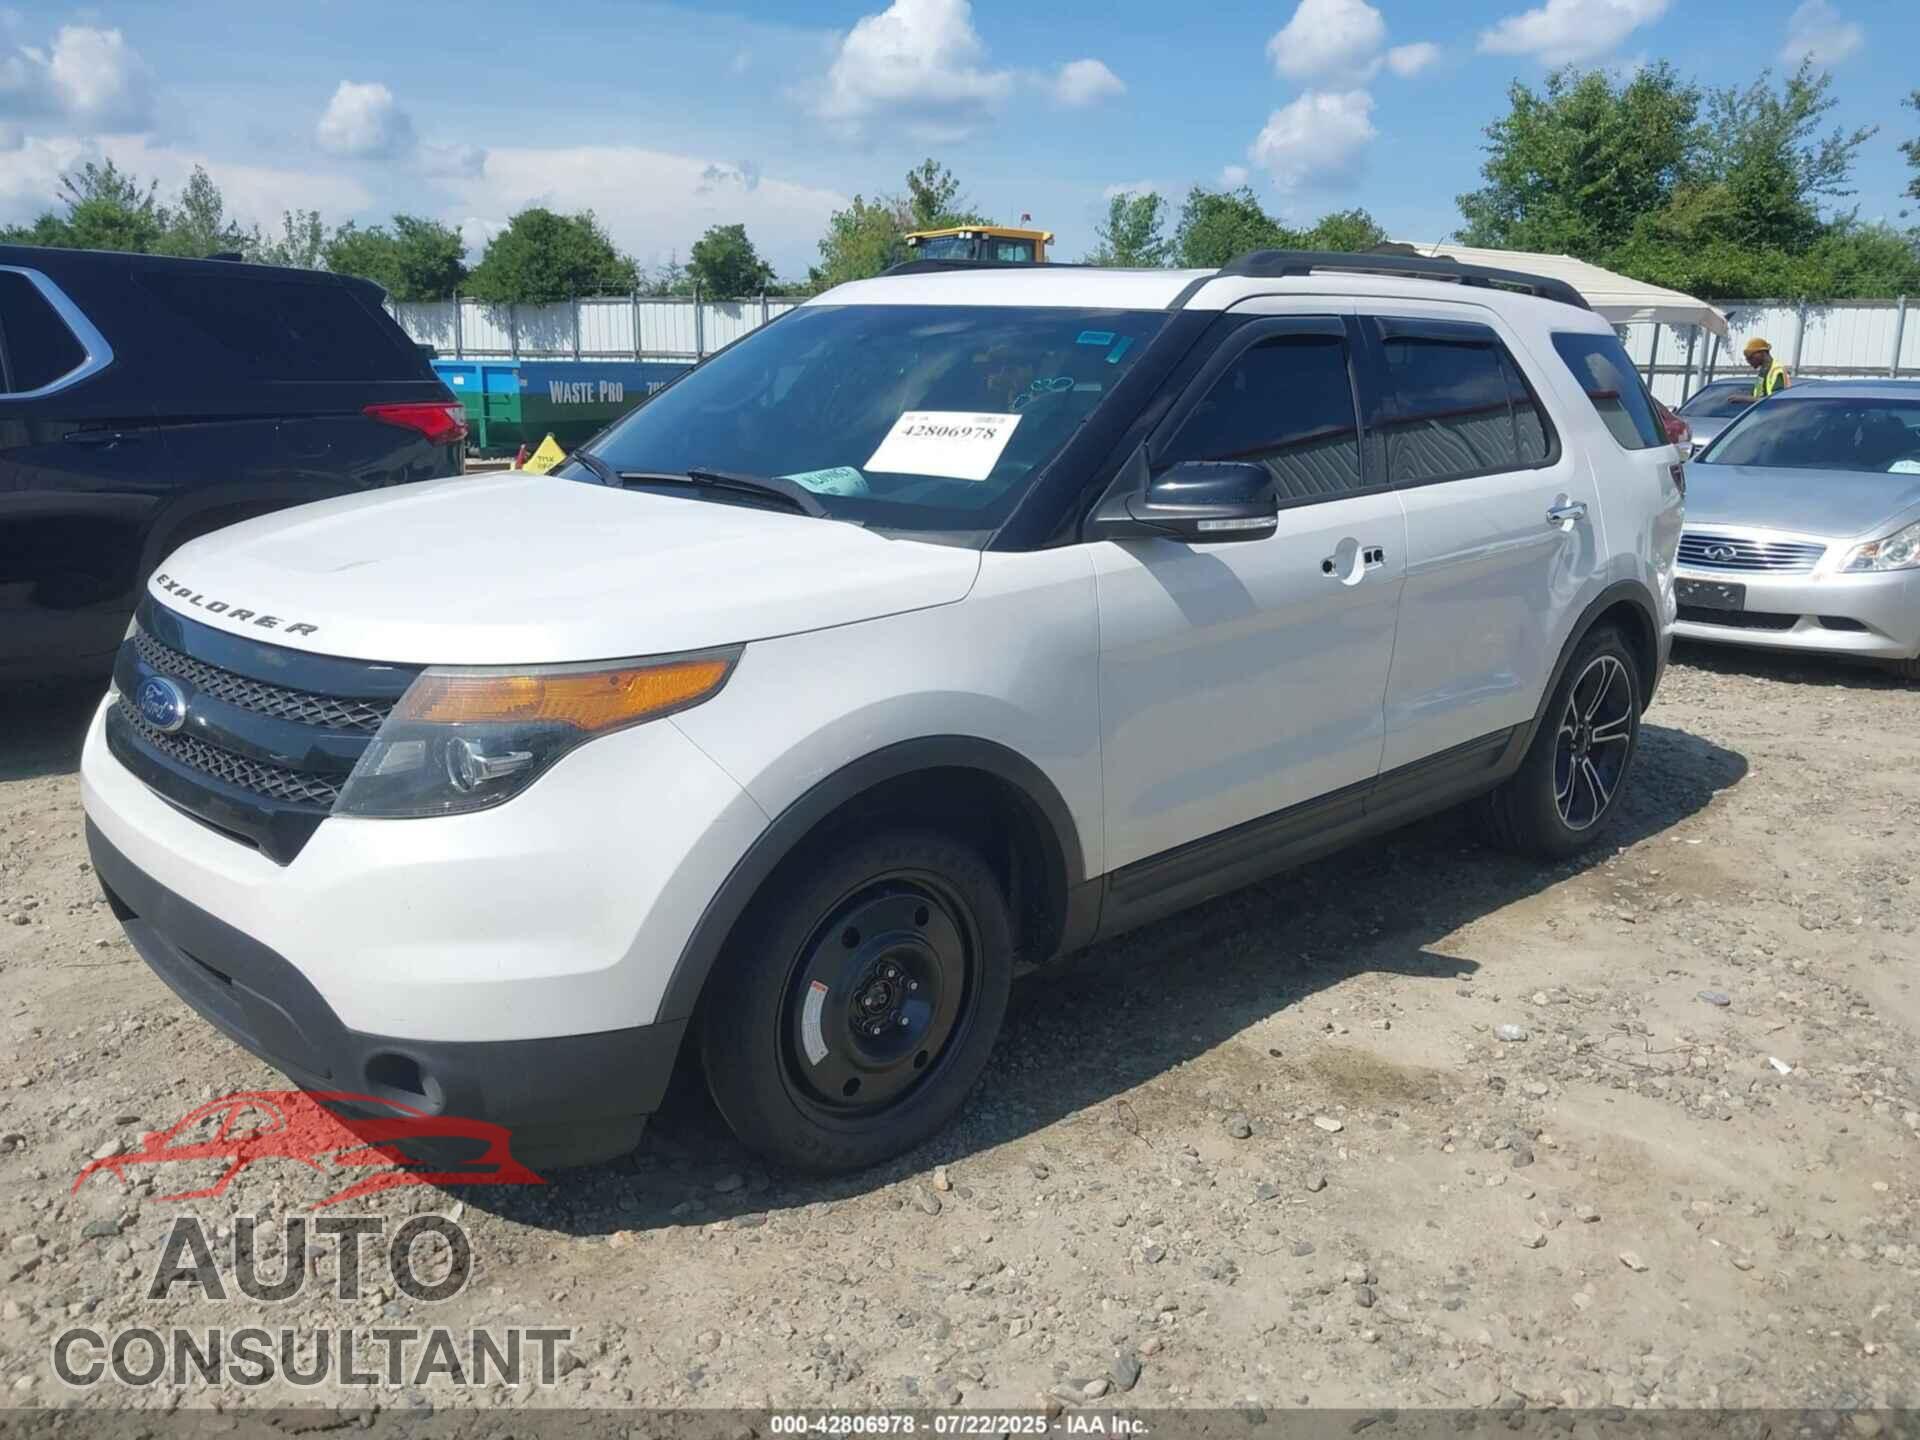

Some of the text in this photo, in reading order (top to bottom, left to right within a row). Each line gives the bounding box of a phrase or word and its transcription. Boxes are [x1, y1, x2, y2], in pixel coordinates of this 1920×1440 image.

[901, 424, 998, 440] 42806978
[156, 573, 319, 637] EXPLORER
[143, 683, 170, 720] Ford
